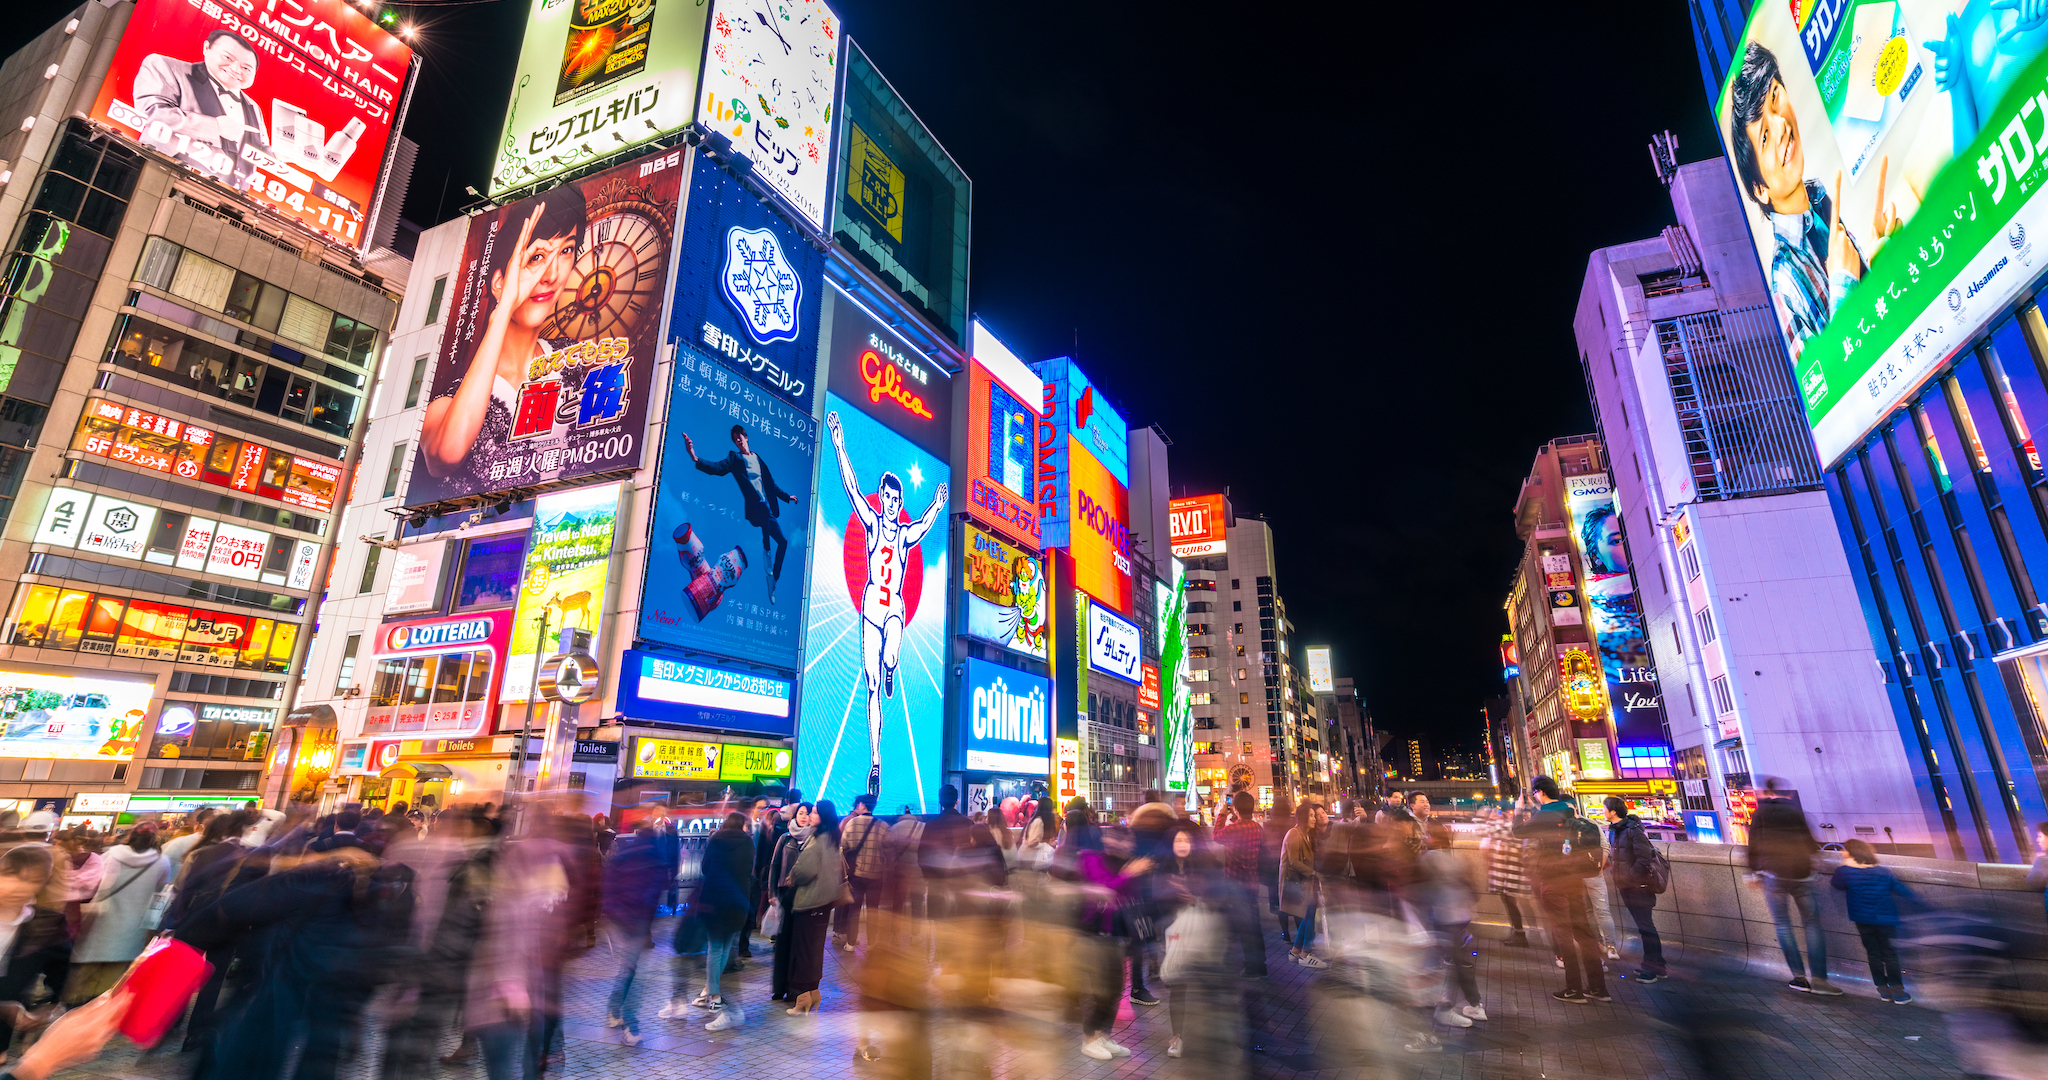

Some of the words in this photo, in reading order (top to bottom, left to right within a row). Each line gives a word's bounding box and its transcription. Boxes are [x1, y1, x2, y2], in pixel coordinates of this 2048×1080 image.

[267, 0, 398, 83] ンヘアー
[258, 12, 339, 72] MILLION
[344, 67, 393, 106] HAIR
[529, 84, 660, 155] ピップエレキバン
[755, 119, 802, 176] ピップ
[248, 150, 290, 176] ルアン
[639, 151, 681, 179] MBS
[794, 189, 819, 219] 2018
[1966, 256, 2009, 299] Hisamitsu
[449, 260, 478, 365] 見る目が変わります。
[527, 337, 631, 380] 教えてもらう
[703, 321, 805, 397] 雪印メグミルク
[868, 332, 928, 386] おいしさと健康
[1867, 326, 1944, 399] 貼るを、未来へ。
[681, 350, 815, 438] 道頓堀のおいしいものと
[861, 350, 934, 420] Glico
[86, 437, 111, 454] 5F
[489, 448, 561, 481] 毎週火曜
[560, 439, 584, 466] PM
[583, 433, 634, 464] 8:00
[1571, 478, 1588, 488] FX
[1573, 487, 1609, 497] GMO
[536, 526, 571, 545] Travel
[572, 531, 580, 540] to
[581, 523, 611, 538] Nara
[1078, 489, 1131, 557] PROMISE
[1170, 509, 1207, 537] B.V.D.
[187, 528, 211, 543] 女性
[215, 535, 266, 553] のお客様
[531, 554, 541, 563] on
[543, 544, 597, 562] Kintetsu.
[975, 533, 1008, 563] かぜに
[1175, 544, 1212, 556] FUJIBO
[230, 550, 263, 570] 0円
[1112, 549, 1131, 577] プロミス
[879, 545, 894, 607] グリコ
[971, 554, 1011, 597] 改源
[188, 617, 238, 644] 風月
[647, 608, 682, 627] New!
[410, 620, 487, 645] LOTTERIA
[81, 641, 112, 653] 営業時間
[1103, 636, 1130, 665] サムティ
[652, 659, 783, 698] 雪印メグミルクからのお知らせ
[1617, 667, 1655, 684] Life
[448, 740, 475, 752] Toilets
[578, 743, 607, 755] Toilets
[659, 744, 703, 758] 店舗情報館
[745, 749, 774, 771] ピタットハウス
[1583, 743, 1605, 760] 薬
